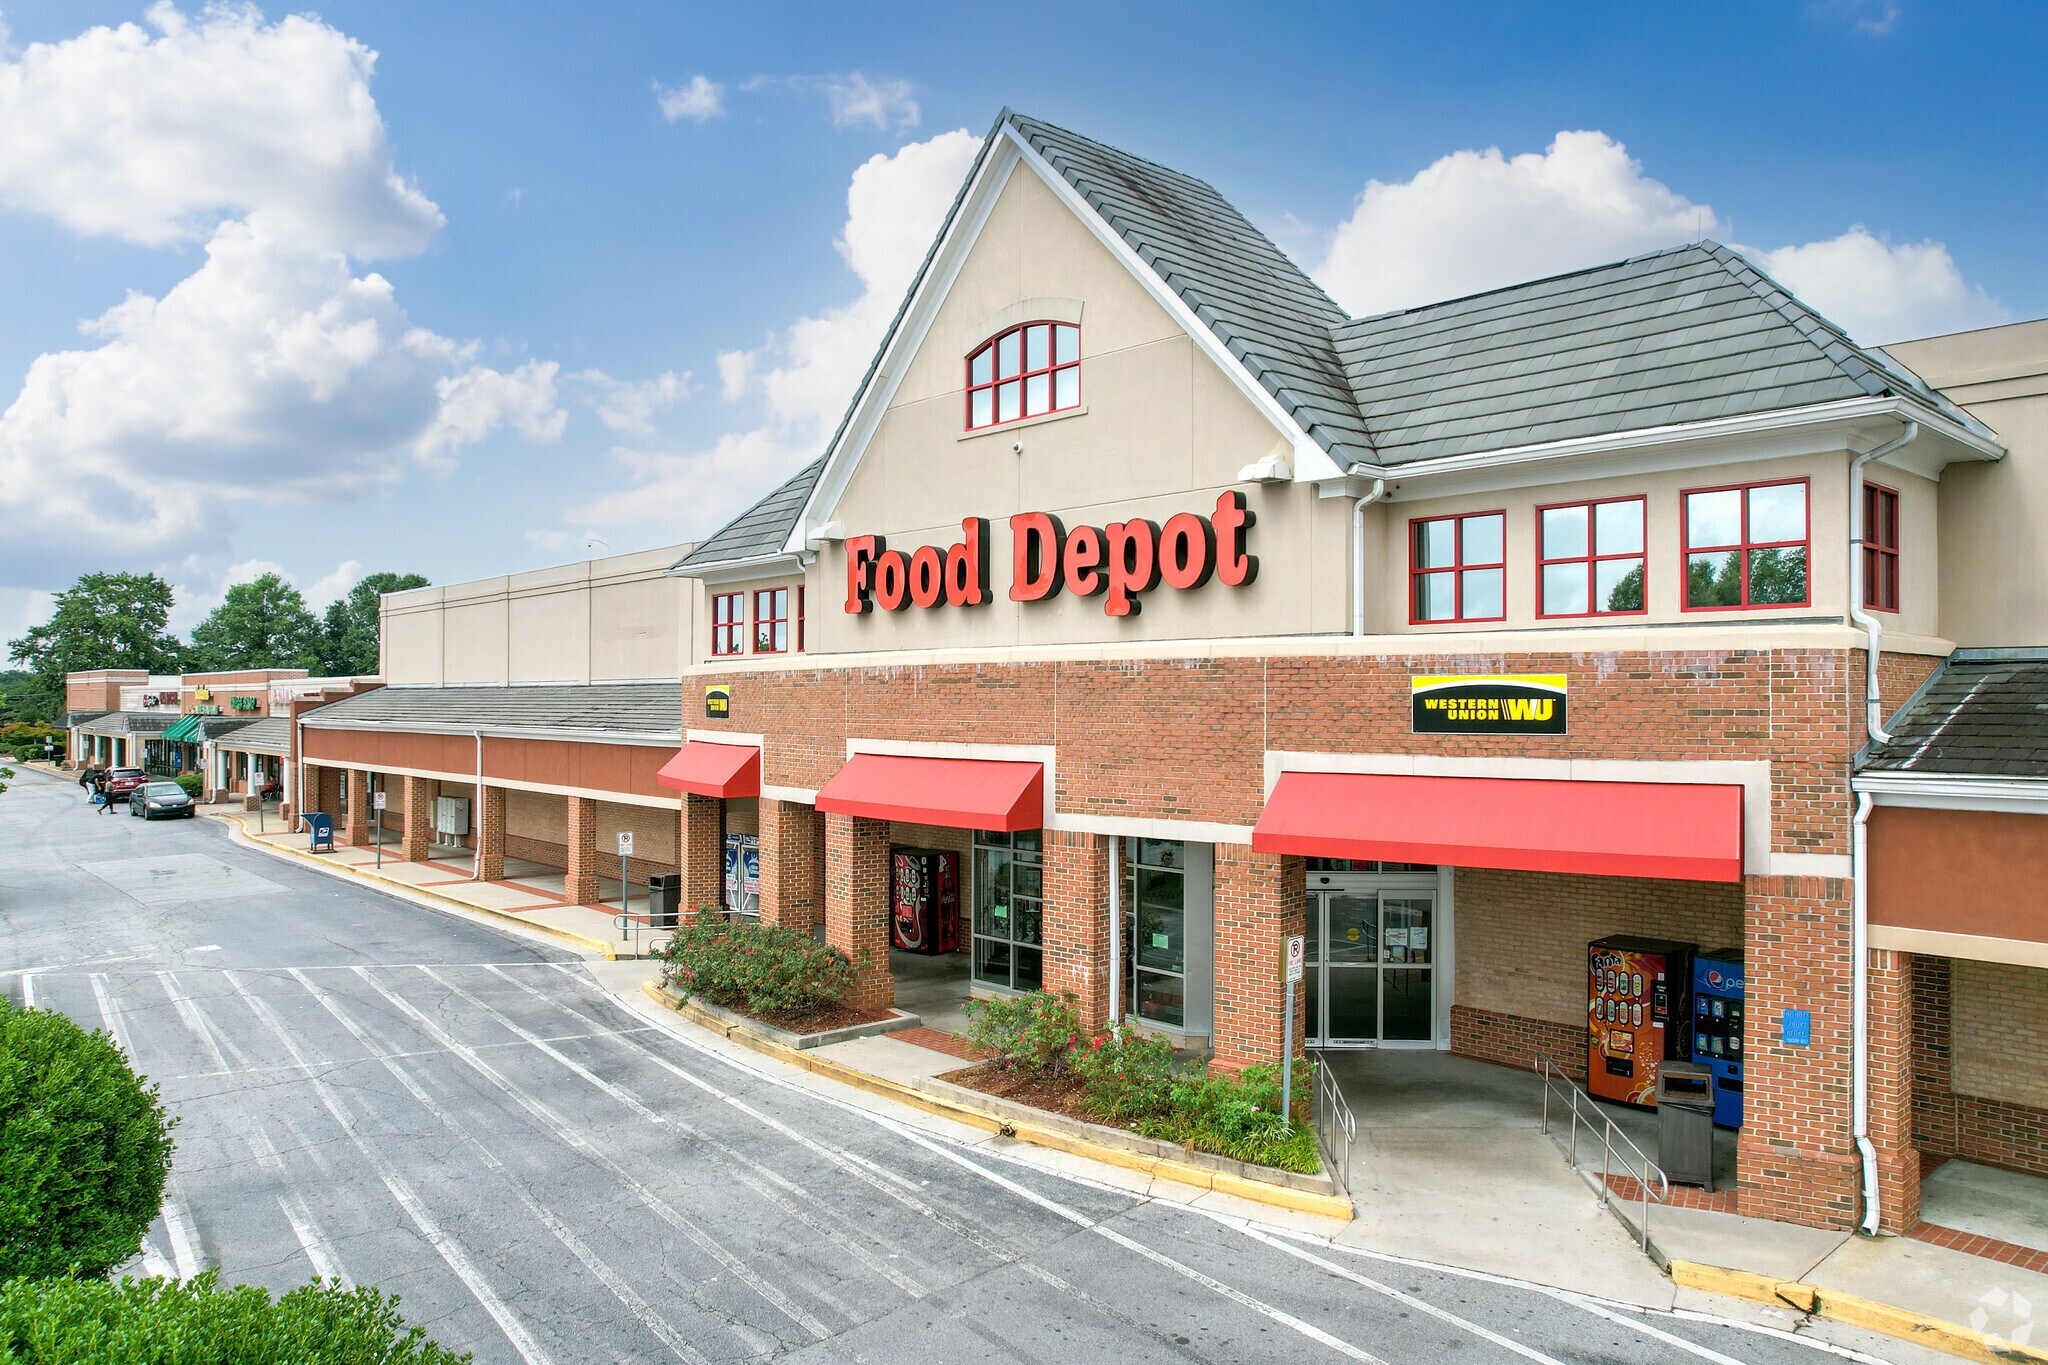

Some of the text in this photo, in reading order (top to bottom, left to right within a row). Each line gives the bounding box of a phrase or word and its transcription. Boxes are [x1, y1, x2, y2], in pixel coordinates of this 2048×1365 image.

[844, 489, 1260, 617] Food Depot
[1424, 698, 1499, 710] WESTERN
[1507, 698, 1554, 721] WU
[1447, 709, 1499, 721] UNION
[1591, 953, 1623, 970] Fanta
